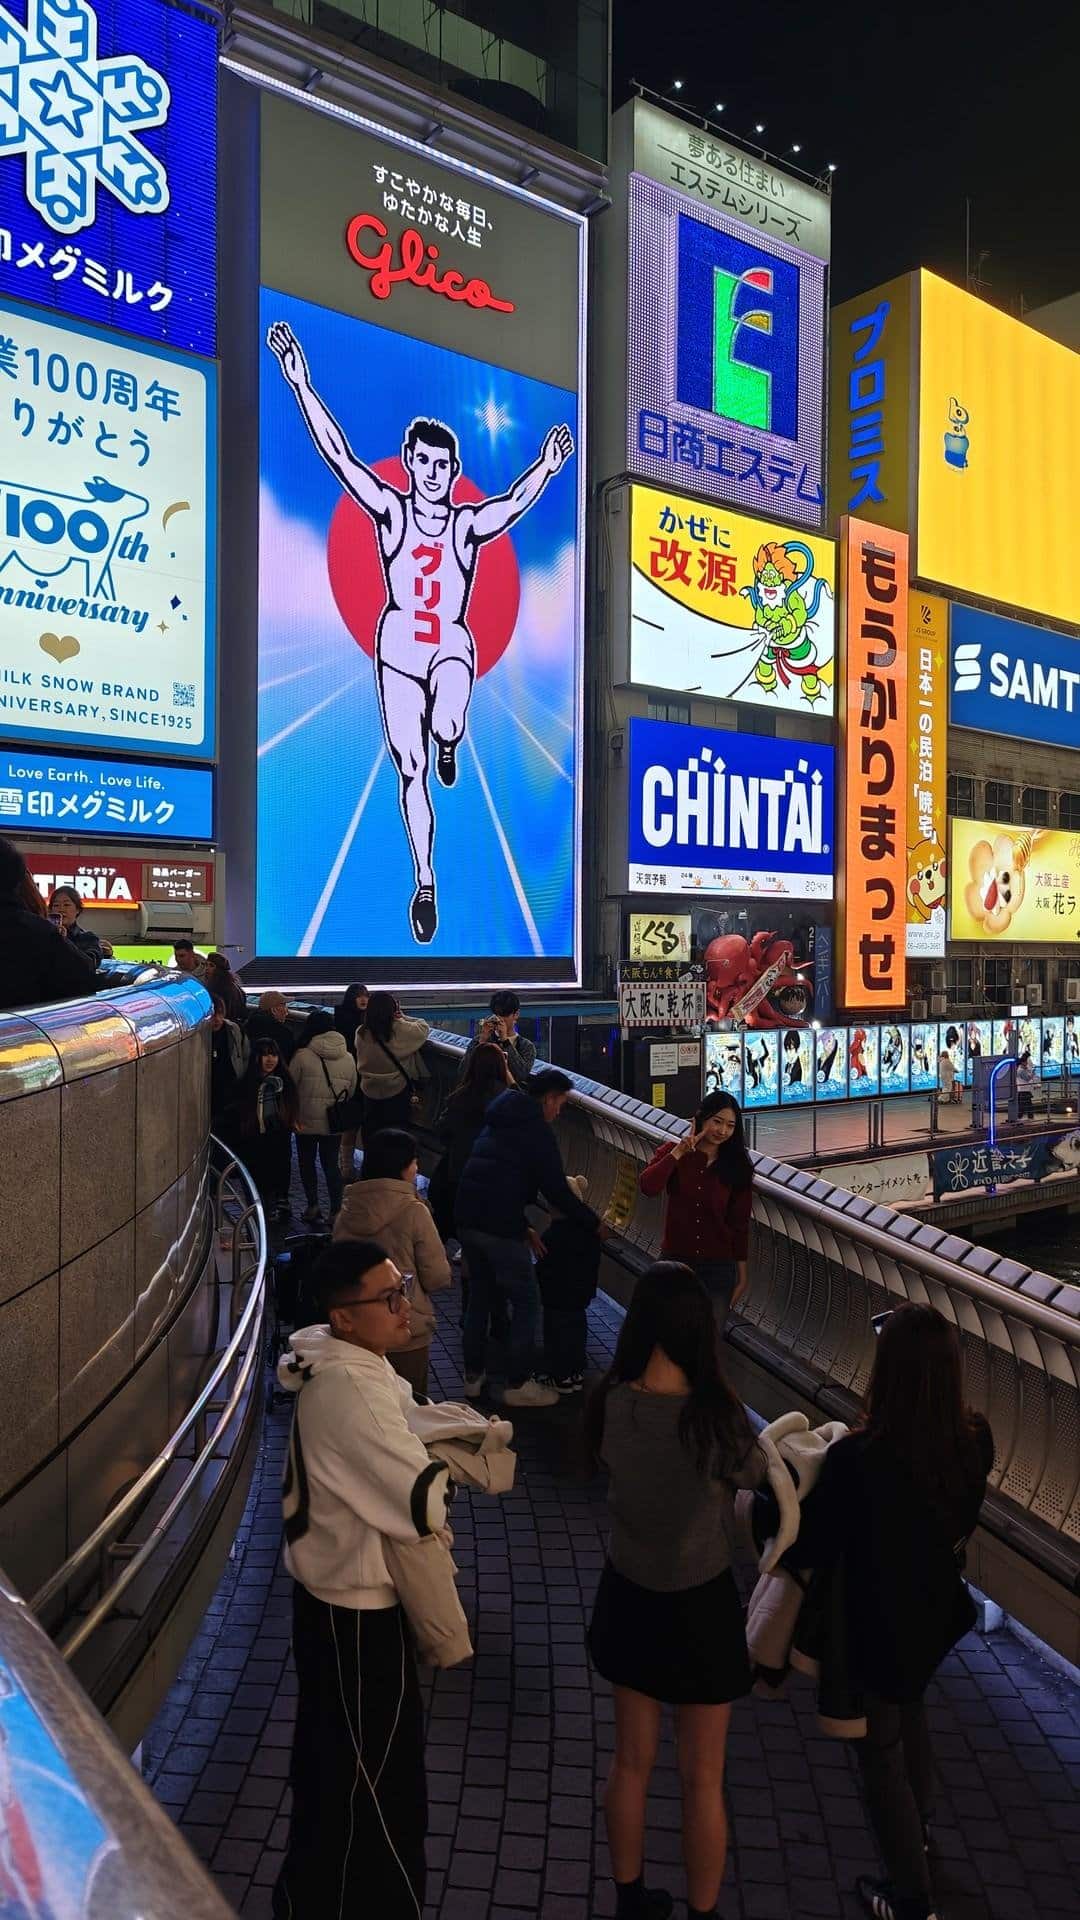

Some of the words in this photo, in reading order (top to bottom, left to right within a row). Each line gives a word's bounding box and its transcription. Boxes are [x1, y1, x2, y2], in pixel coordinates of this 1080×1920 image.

[688, 133, 785, 198] 夢ある住まい
[373, 165, 492, 230] すこやかな毎日、
[383, 192, 482, 248] ゆたかな人生
[670, 161, 801, 242] エステムシリーズ
[346, 214, 515, 312] Glico
[15, 398, 150, 466] りがとう
[849, 301, 891, 510] プロミス
[639, 408, 824, 506] 日商エステム
[659, 506, 731, 549] かぜに
[411, 542, 444, 644] グリコ
[649, 537, 738, 598] 改源
[0, 669, 32, 687] ILK
[41, 675, 94, 694] SNOW
[102, 683, 160, 702] BRAND
[990, 652, 1080, 713] SAMT
[8, 765, 44, 780] Love
[48, 768, 94, 784] Earth.
[100, 773, 132, 788] Love
[135, 775, 165, 790] Life.
[859, 539, 898, 991] もうかりまっせ
[0, 788, 175, 825] 雪印メグミルク
[168, 890, 201, 898] コーヒー
[636, 872, 667, 886] 天気予報
[1035, 873, 1070, 888] 大阪土産
[642, 920, 680, 955] くくる
[625, 990, 694, 1019] 大阪に乾杯
